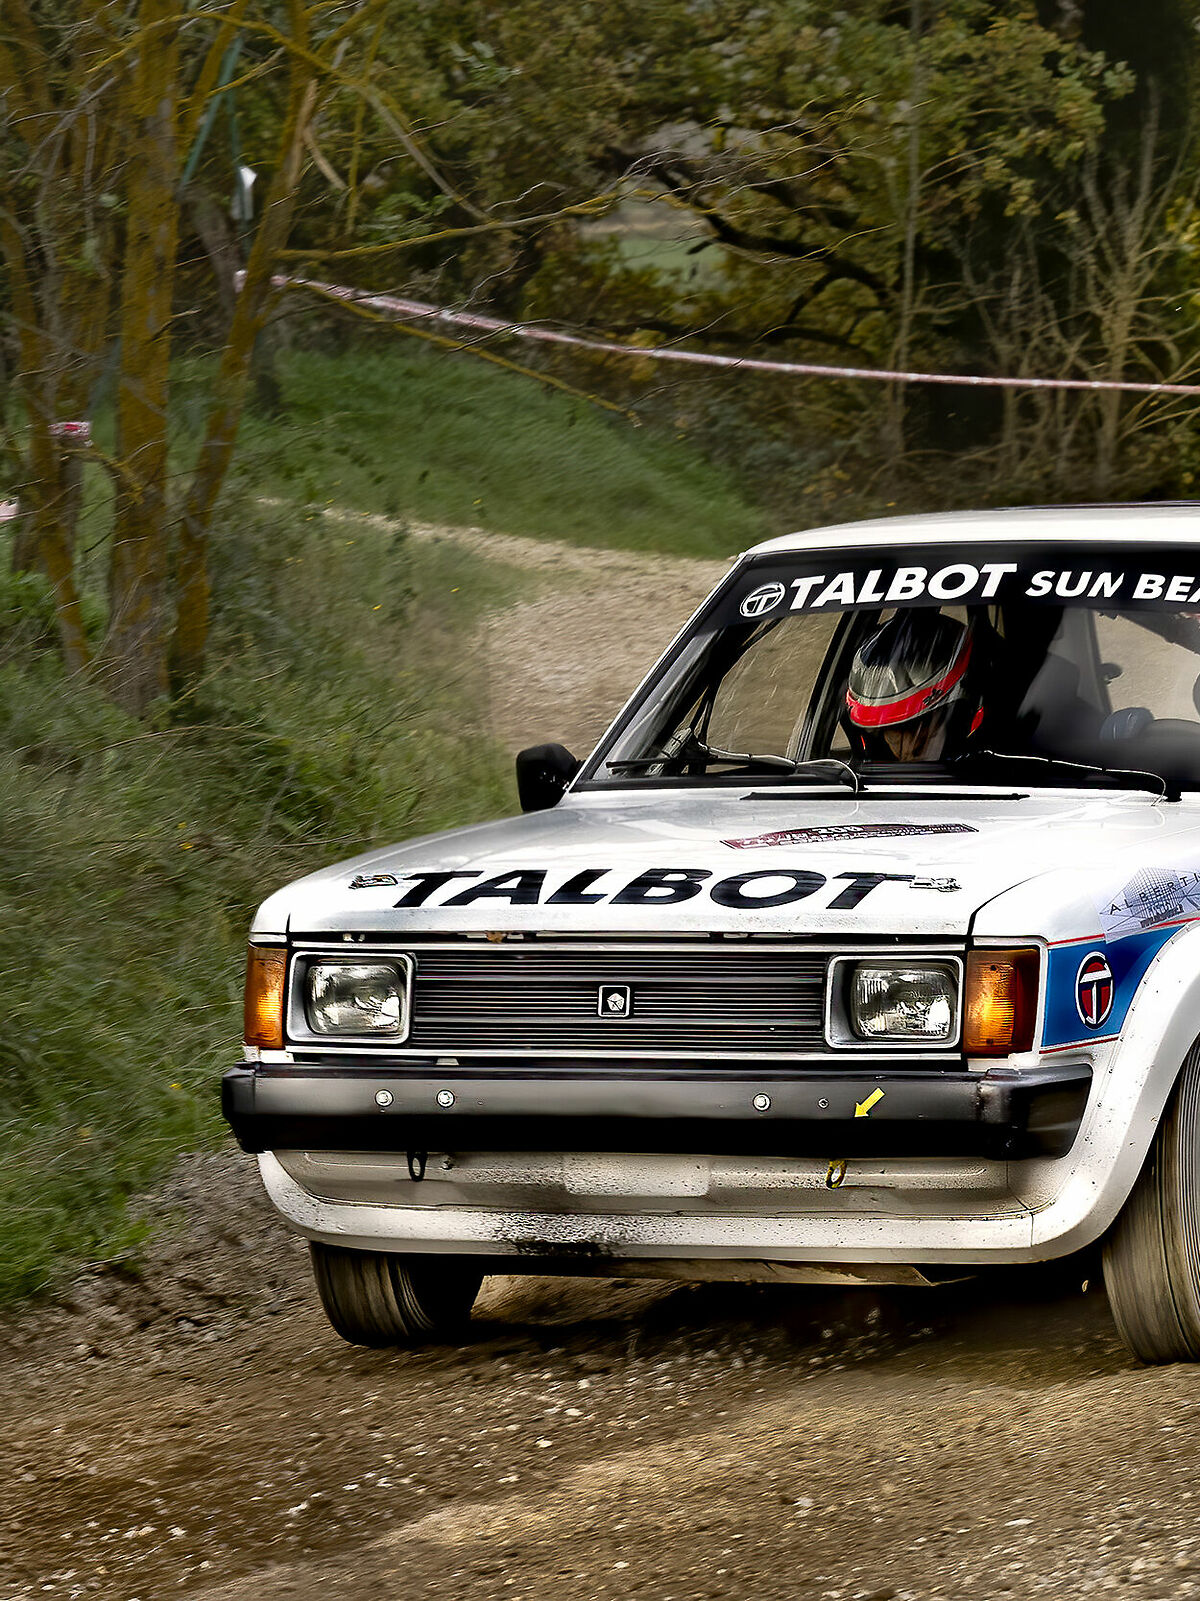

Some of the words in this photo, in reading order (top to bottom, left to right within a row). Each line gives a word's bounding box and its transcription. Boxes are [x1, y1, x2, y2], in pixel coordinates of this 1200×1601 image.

[789, 563, 1017, 611] TALBOT
[1025, 570, 1125, 598] SUN
[393, 868, 916, 911] TALBOT
[1110, 873, 1200, 915] ALBERTI
